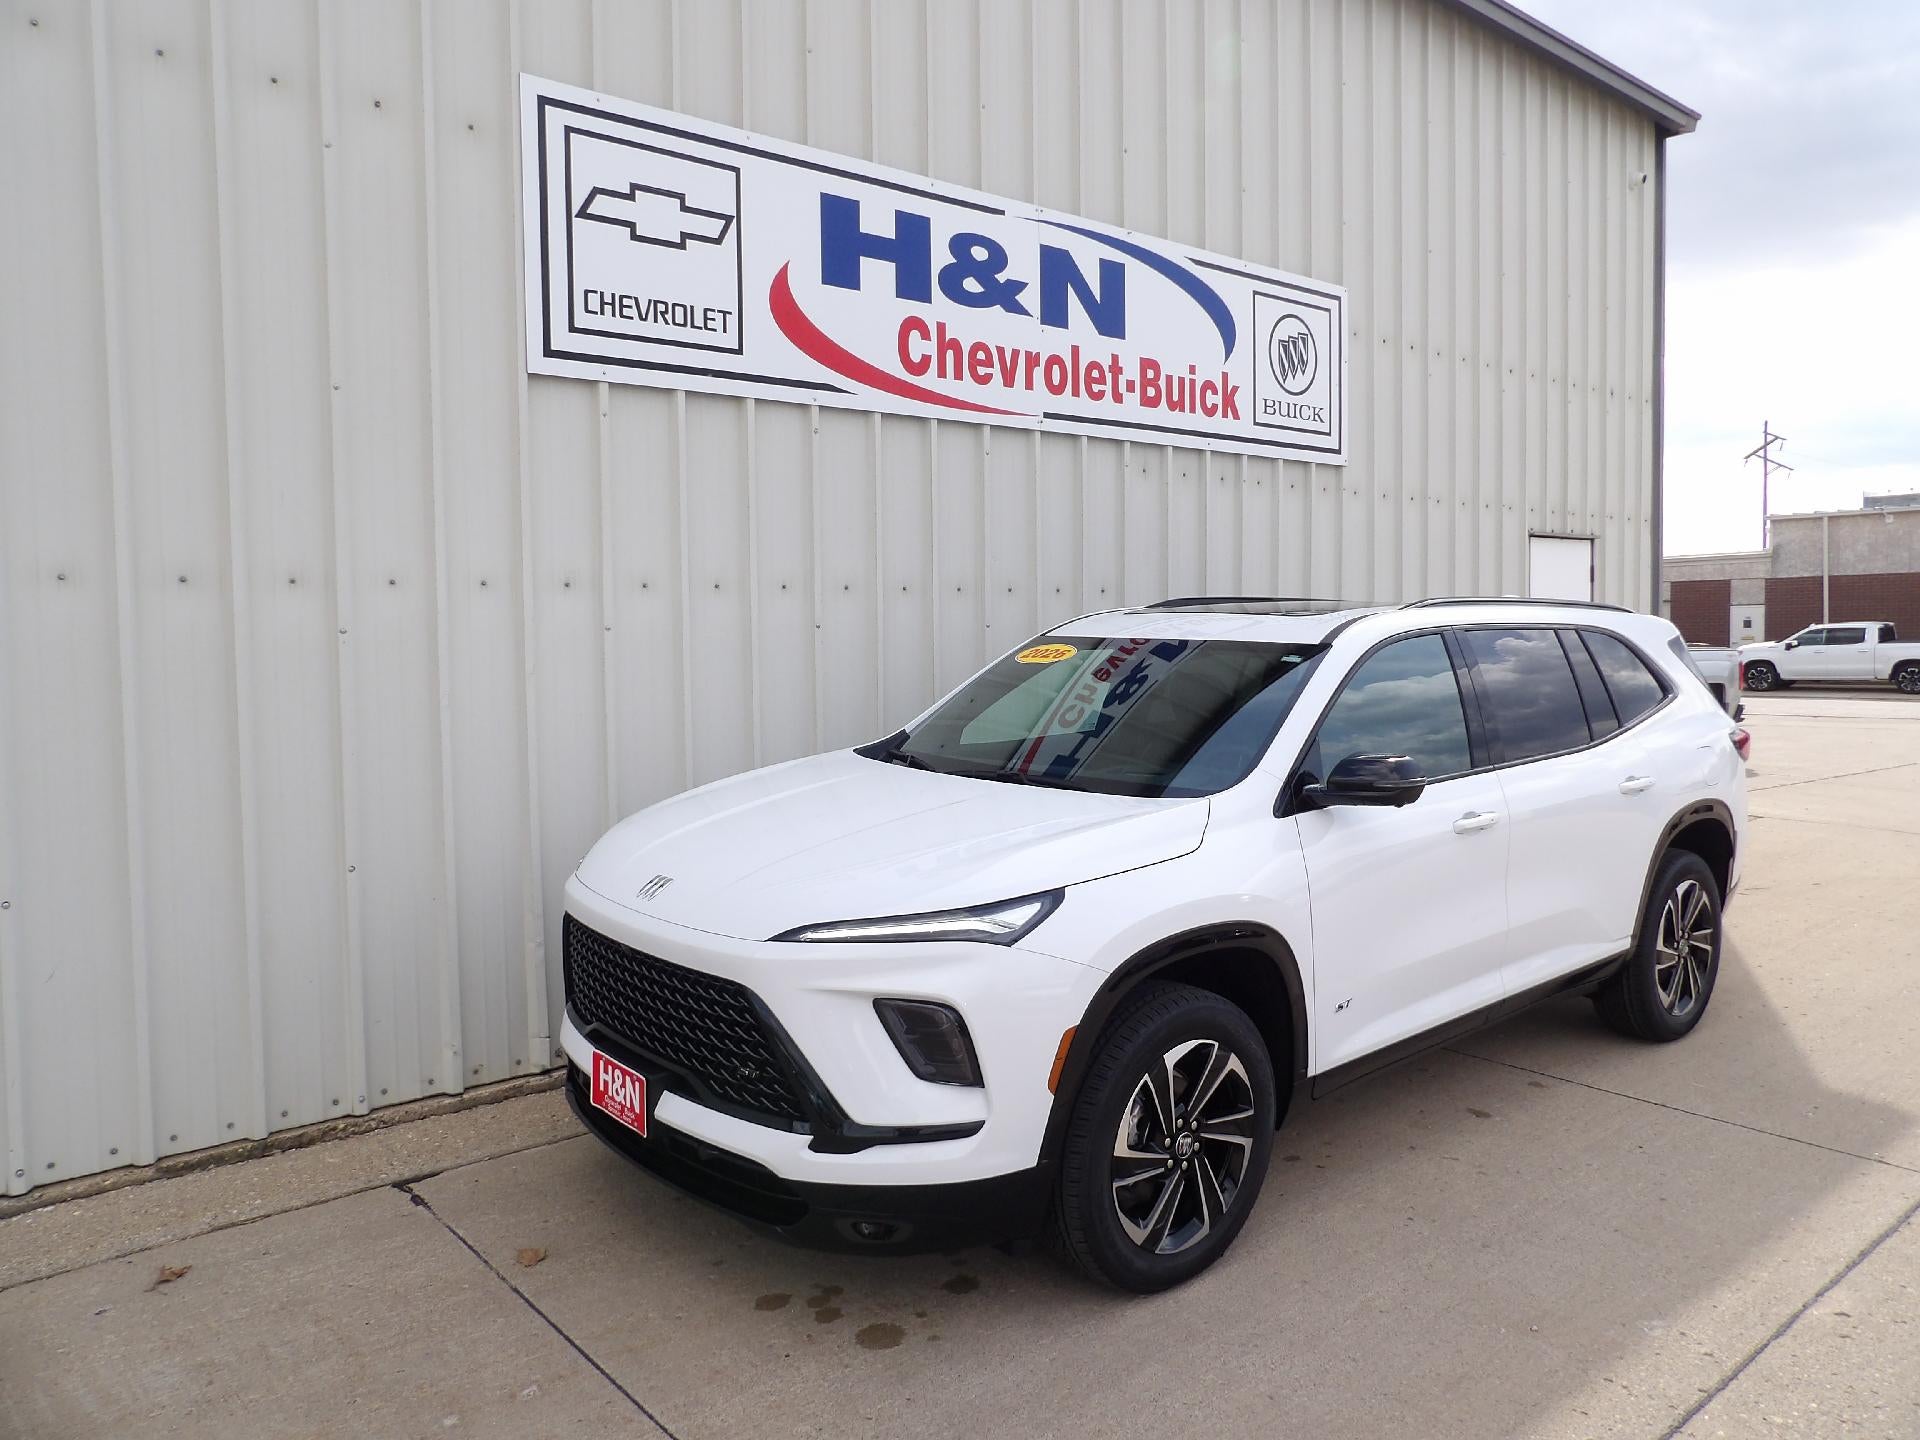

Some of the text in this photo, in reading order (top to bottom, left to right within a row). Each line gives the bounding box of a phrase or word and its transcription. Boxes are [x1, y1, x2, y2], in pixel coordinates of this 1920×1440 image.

[820, 192, 1126, 340] H&N
[583, 288, 733, 334] CHEVROLET
[1262, 397, 1326, 423] BUICK
[1019, 648, 1072, 659] 2026
[1335, 998, 1352, 1013] ST
[599, 1059, 640, 1114] H&N
